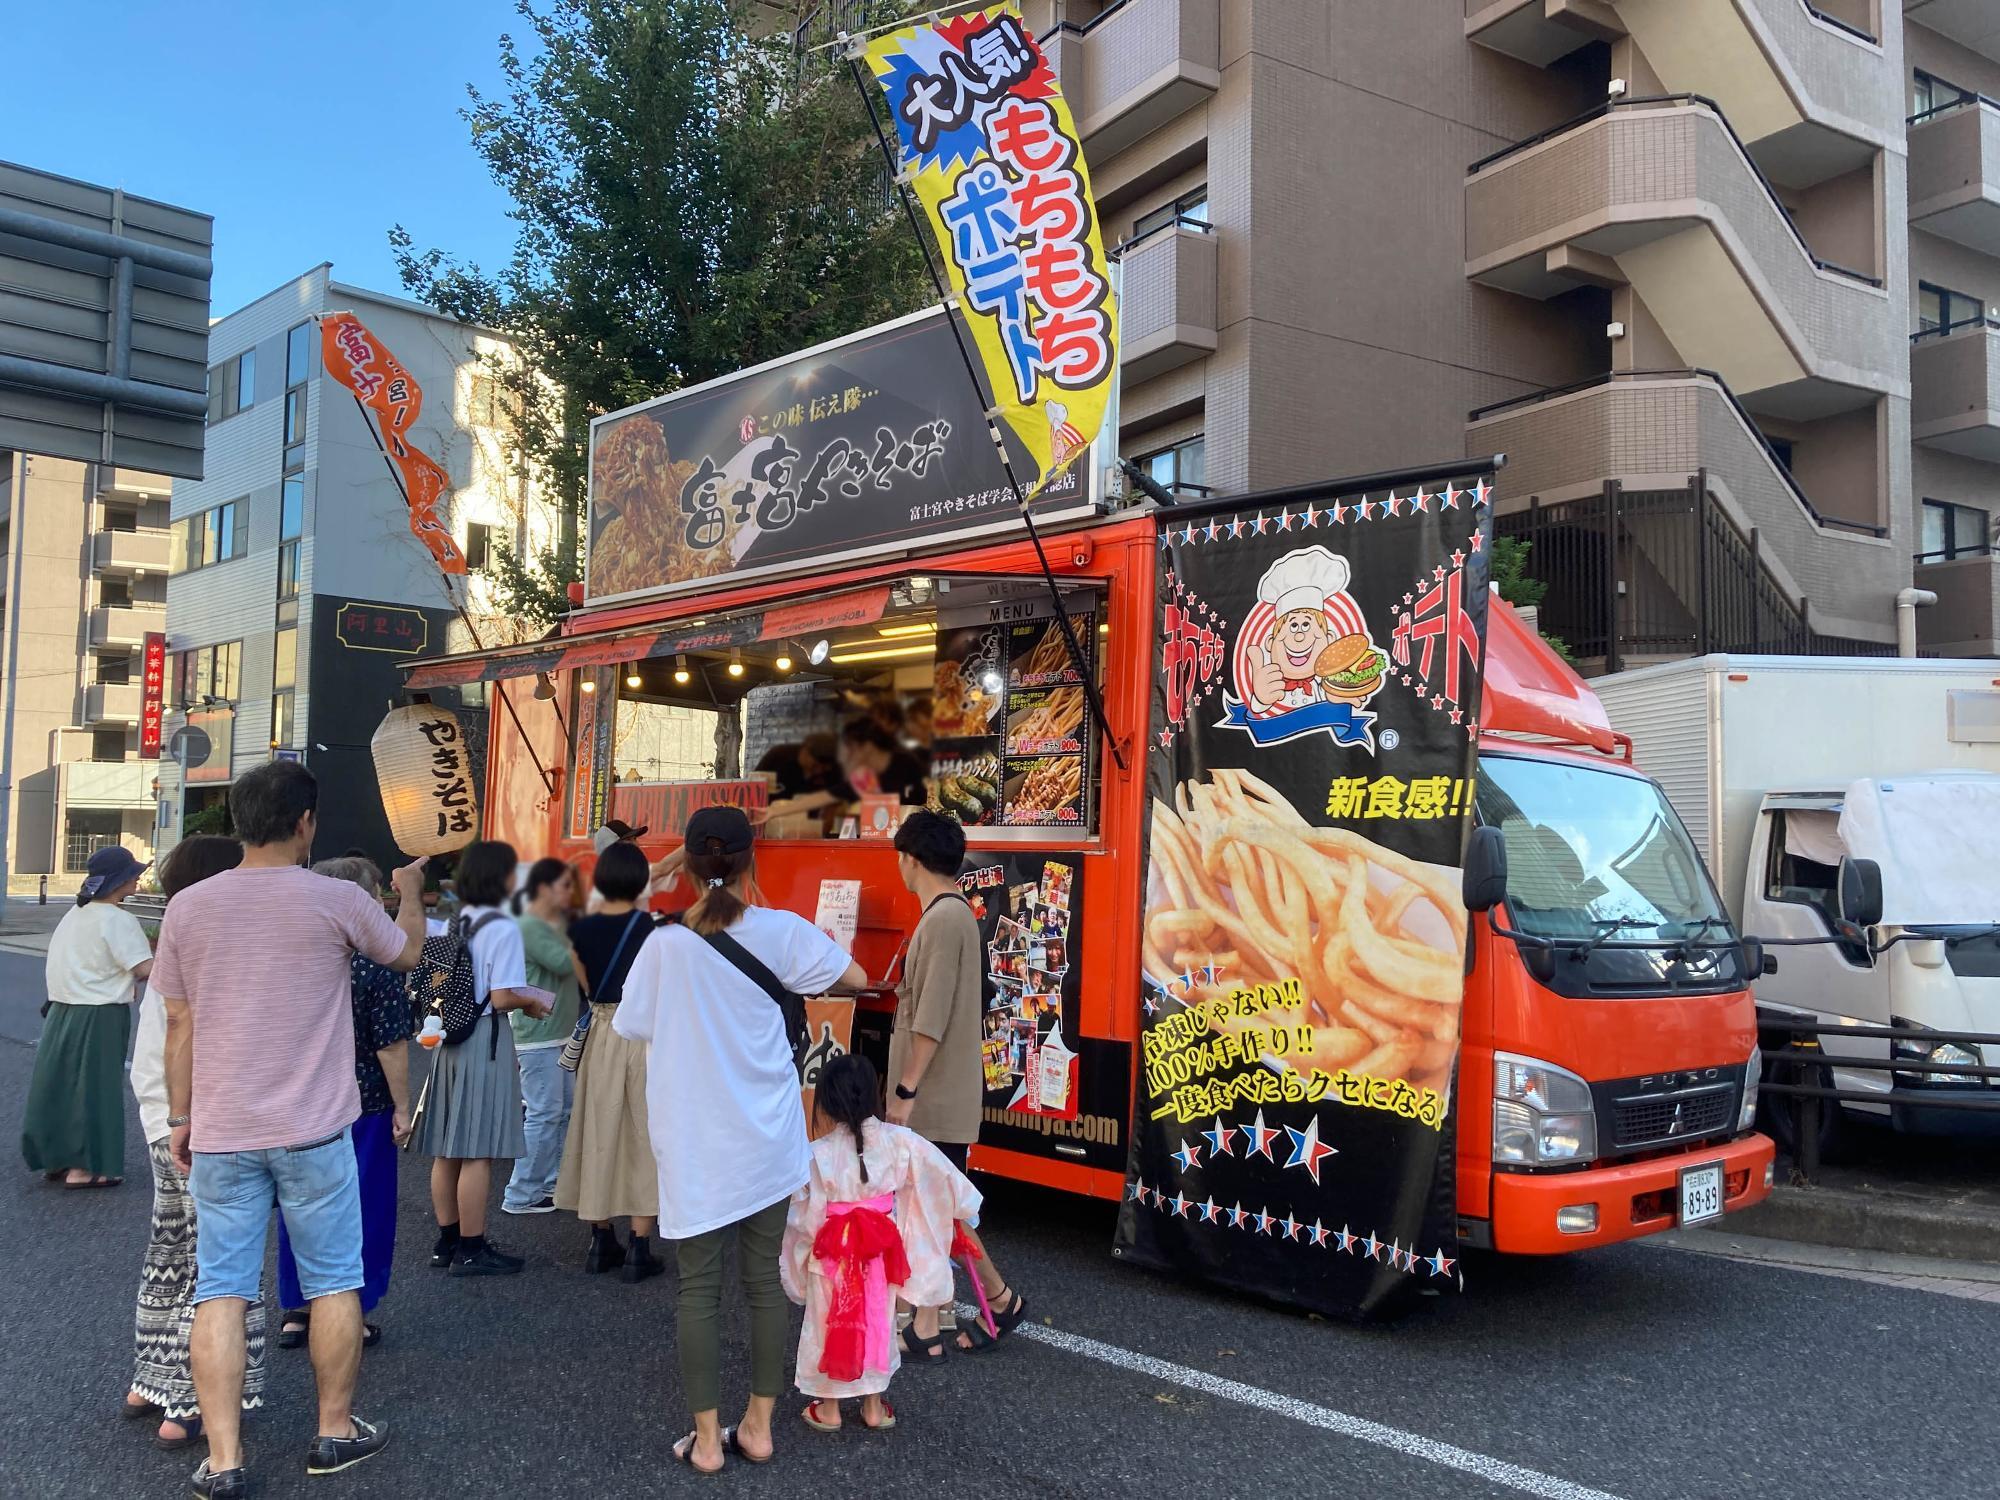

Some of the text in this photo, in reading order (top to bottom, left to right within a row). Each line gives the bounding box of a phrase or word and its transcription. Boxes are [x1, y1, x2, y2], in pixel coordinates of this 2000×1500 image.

[906, 19, 1031, 145] 大人気!
[944, 167, 1044, 397] ポテト
[992, 100, 1105, 383] もちもち
[758, 404, 804, 434] この味
[682, 421, 950, 549] 富士宮やきそば
[347, 613, 412, 635] 阿里山
[989, 603, 1034, 621] MENU
[1162, 592, 1226, 724] もちもち
[1391, 569, 1480, 704] ポテト
[419, 719, 476, 837] やきそば
[1325, 775, 1477, 820] 新食感!!
[1640, 1069, 1718, 1089] FUSO
[1689, 1186, 1717, 1215] 89-89
